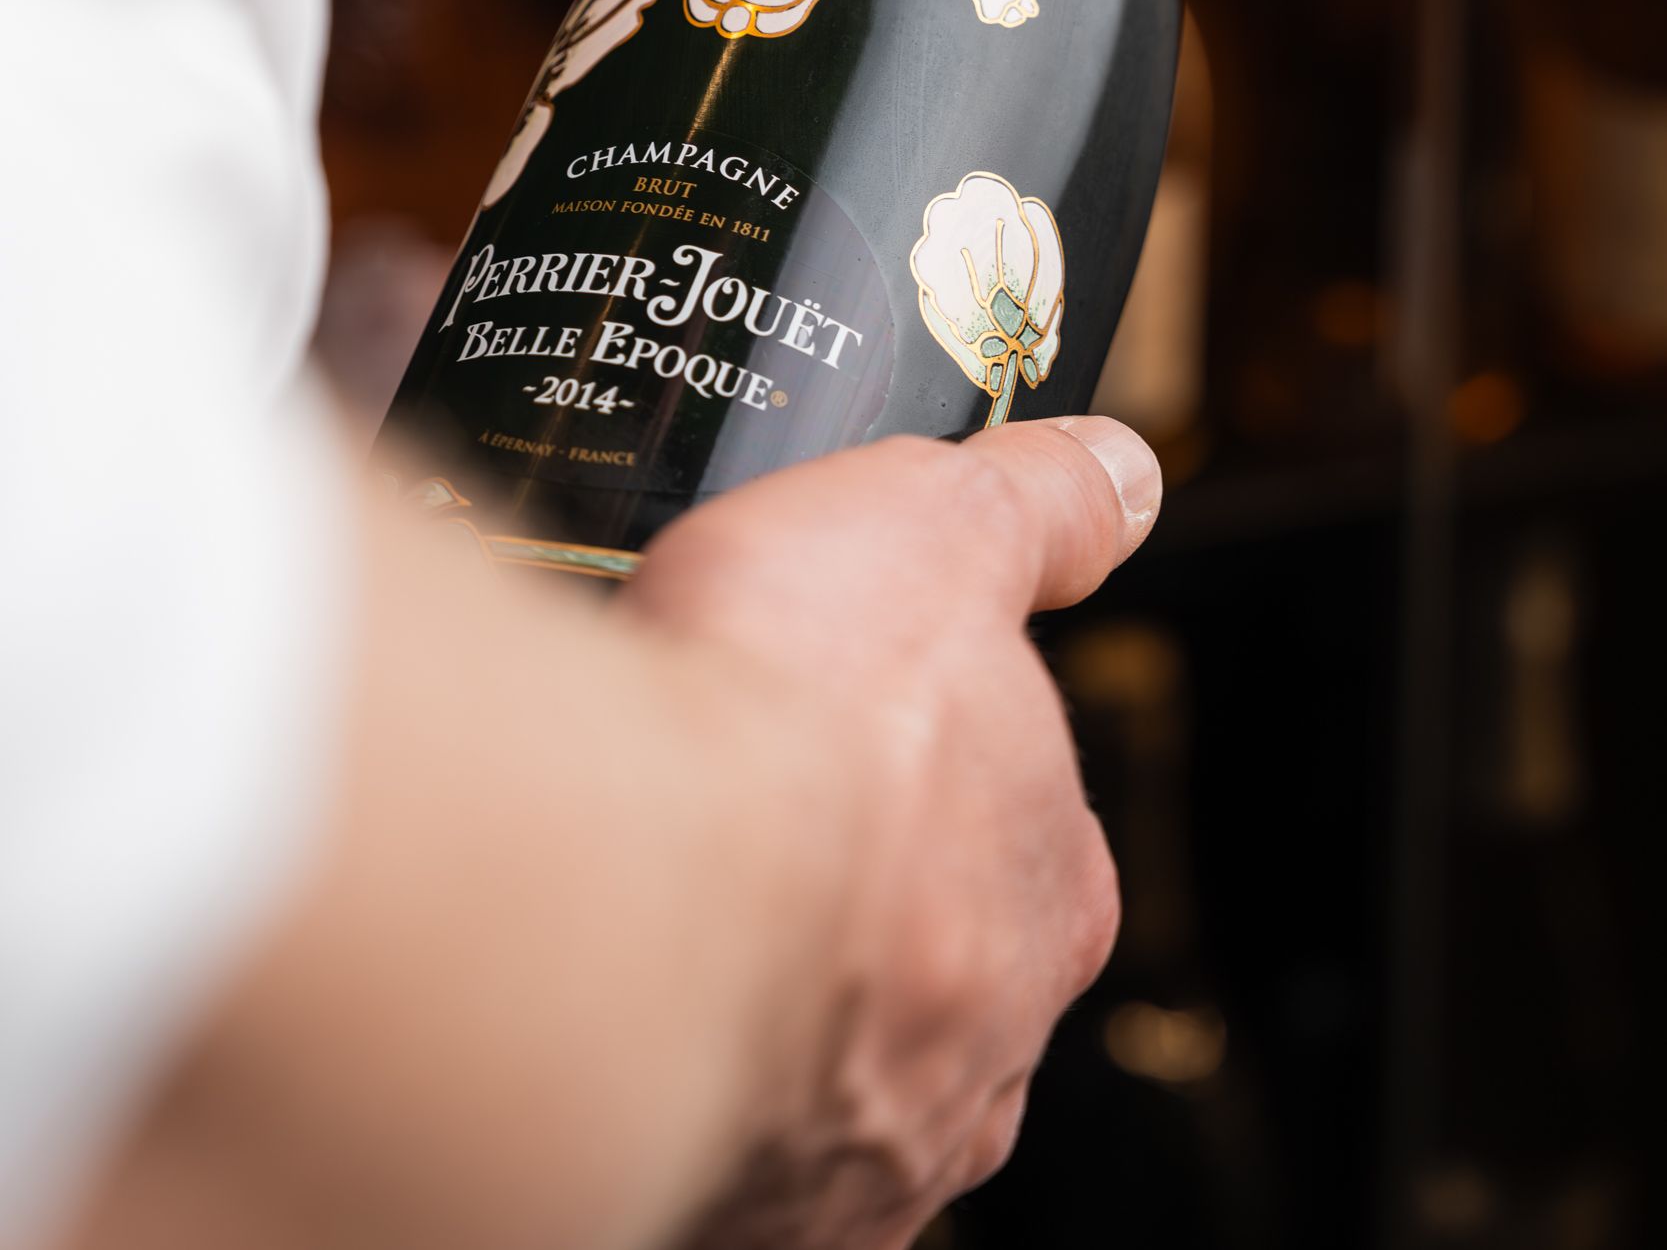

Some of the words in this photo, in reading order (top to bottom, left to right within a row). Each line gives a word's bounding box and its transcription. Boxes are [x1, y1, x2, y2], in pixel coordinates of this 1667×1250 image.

[566, 141, 800, 211] CHAMPAGNE
[633, 176, 697, 199] BRUT
[552, 200, 617, 215] MAISON
[621, 201, 693, 222] FONDÉE
[699, 212, 726, 229] EN
[731, 220, 771, 243] 1811
[438, 243, 864, 370] PERRIER-JOUËT
[456, 321, 584, 363] BELLE
[568, 447, 637, 467] FRANCE
